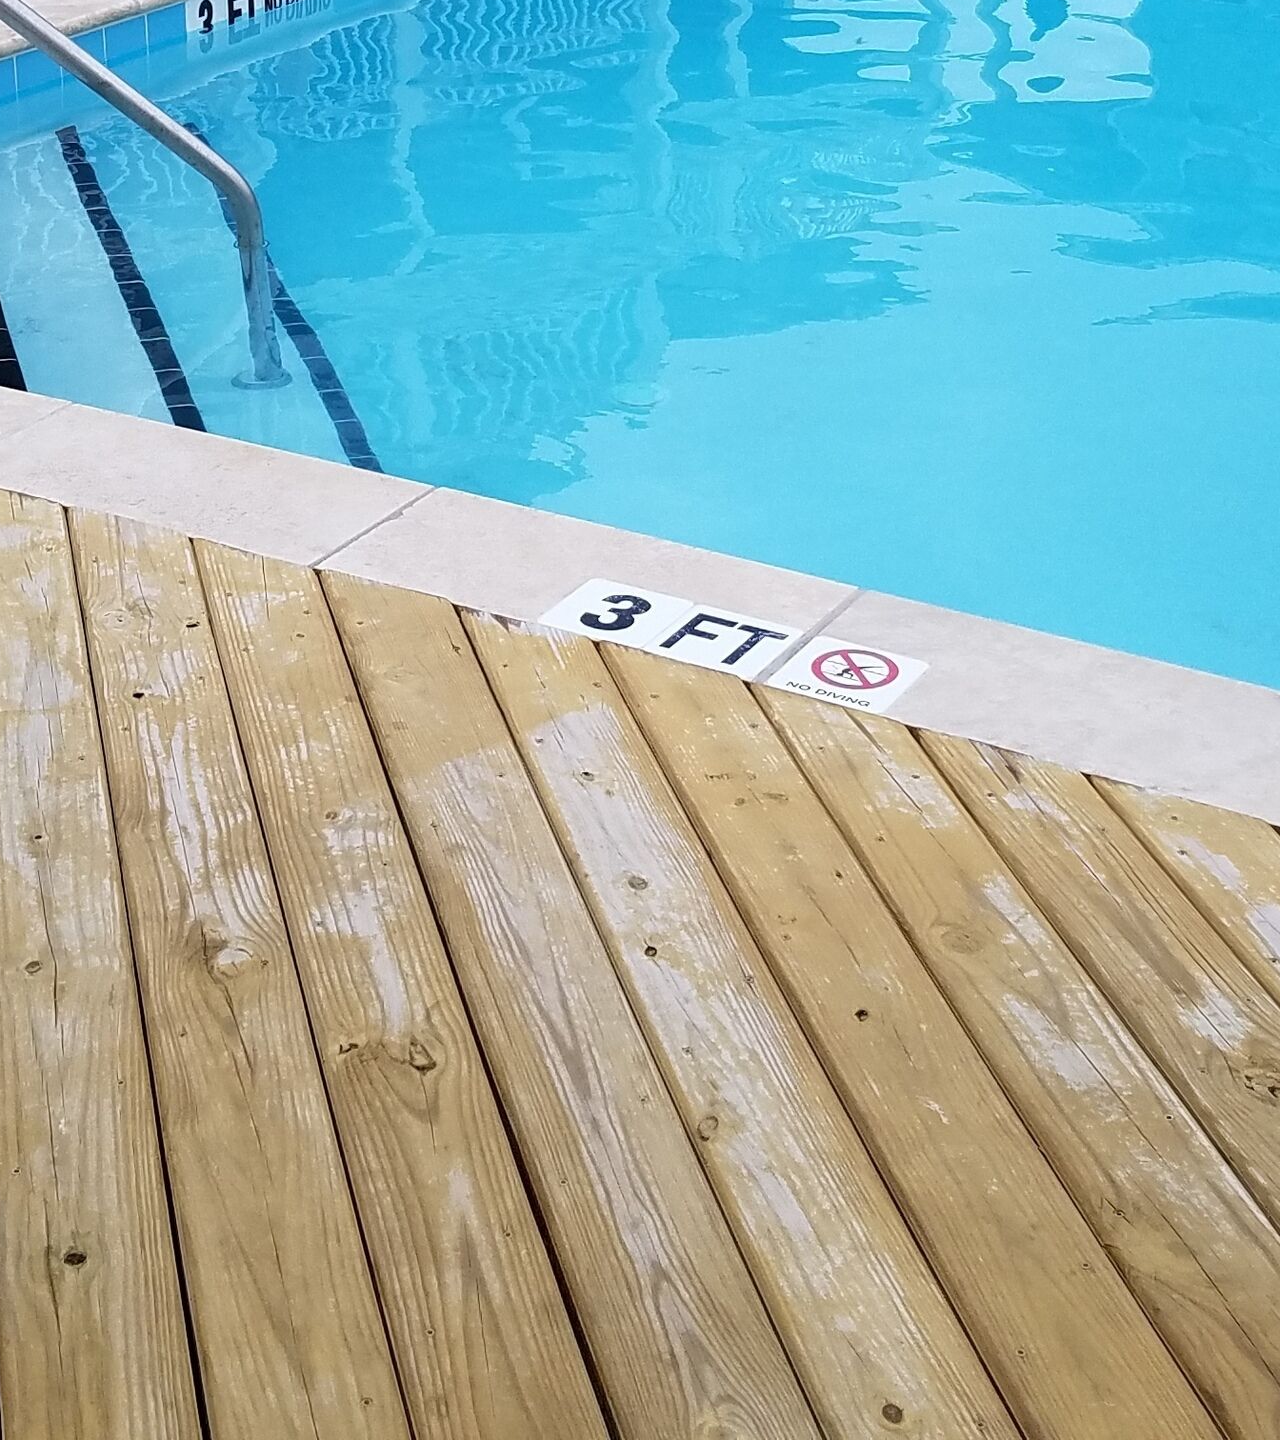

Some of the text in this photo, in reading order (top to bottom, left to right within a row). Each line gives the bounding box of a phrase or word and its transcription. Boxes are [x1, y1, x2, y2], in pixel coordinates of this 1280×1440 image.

[580, 594, 790, 665] 3 FT
[785, 679, 872, 708] NO DIVING
